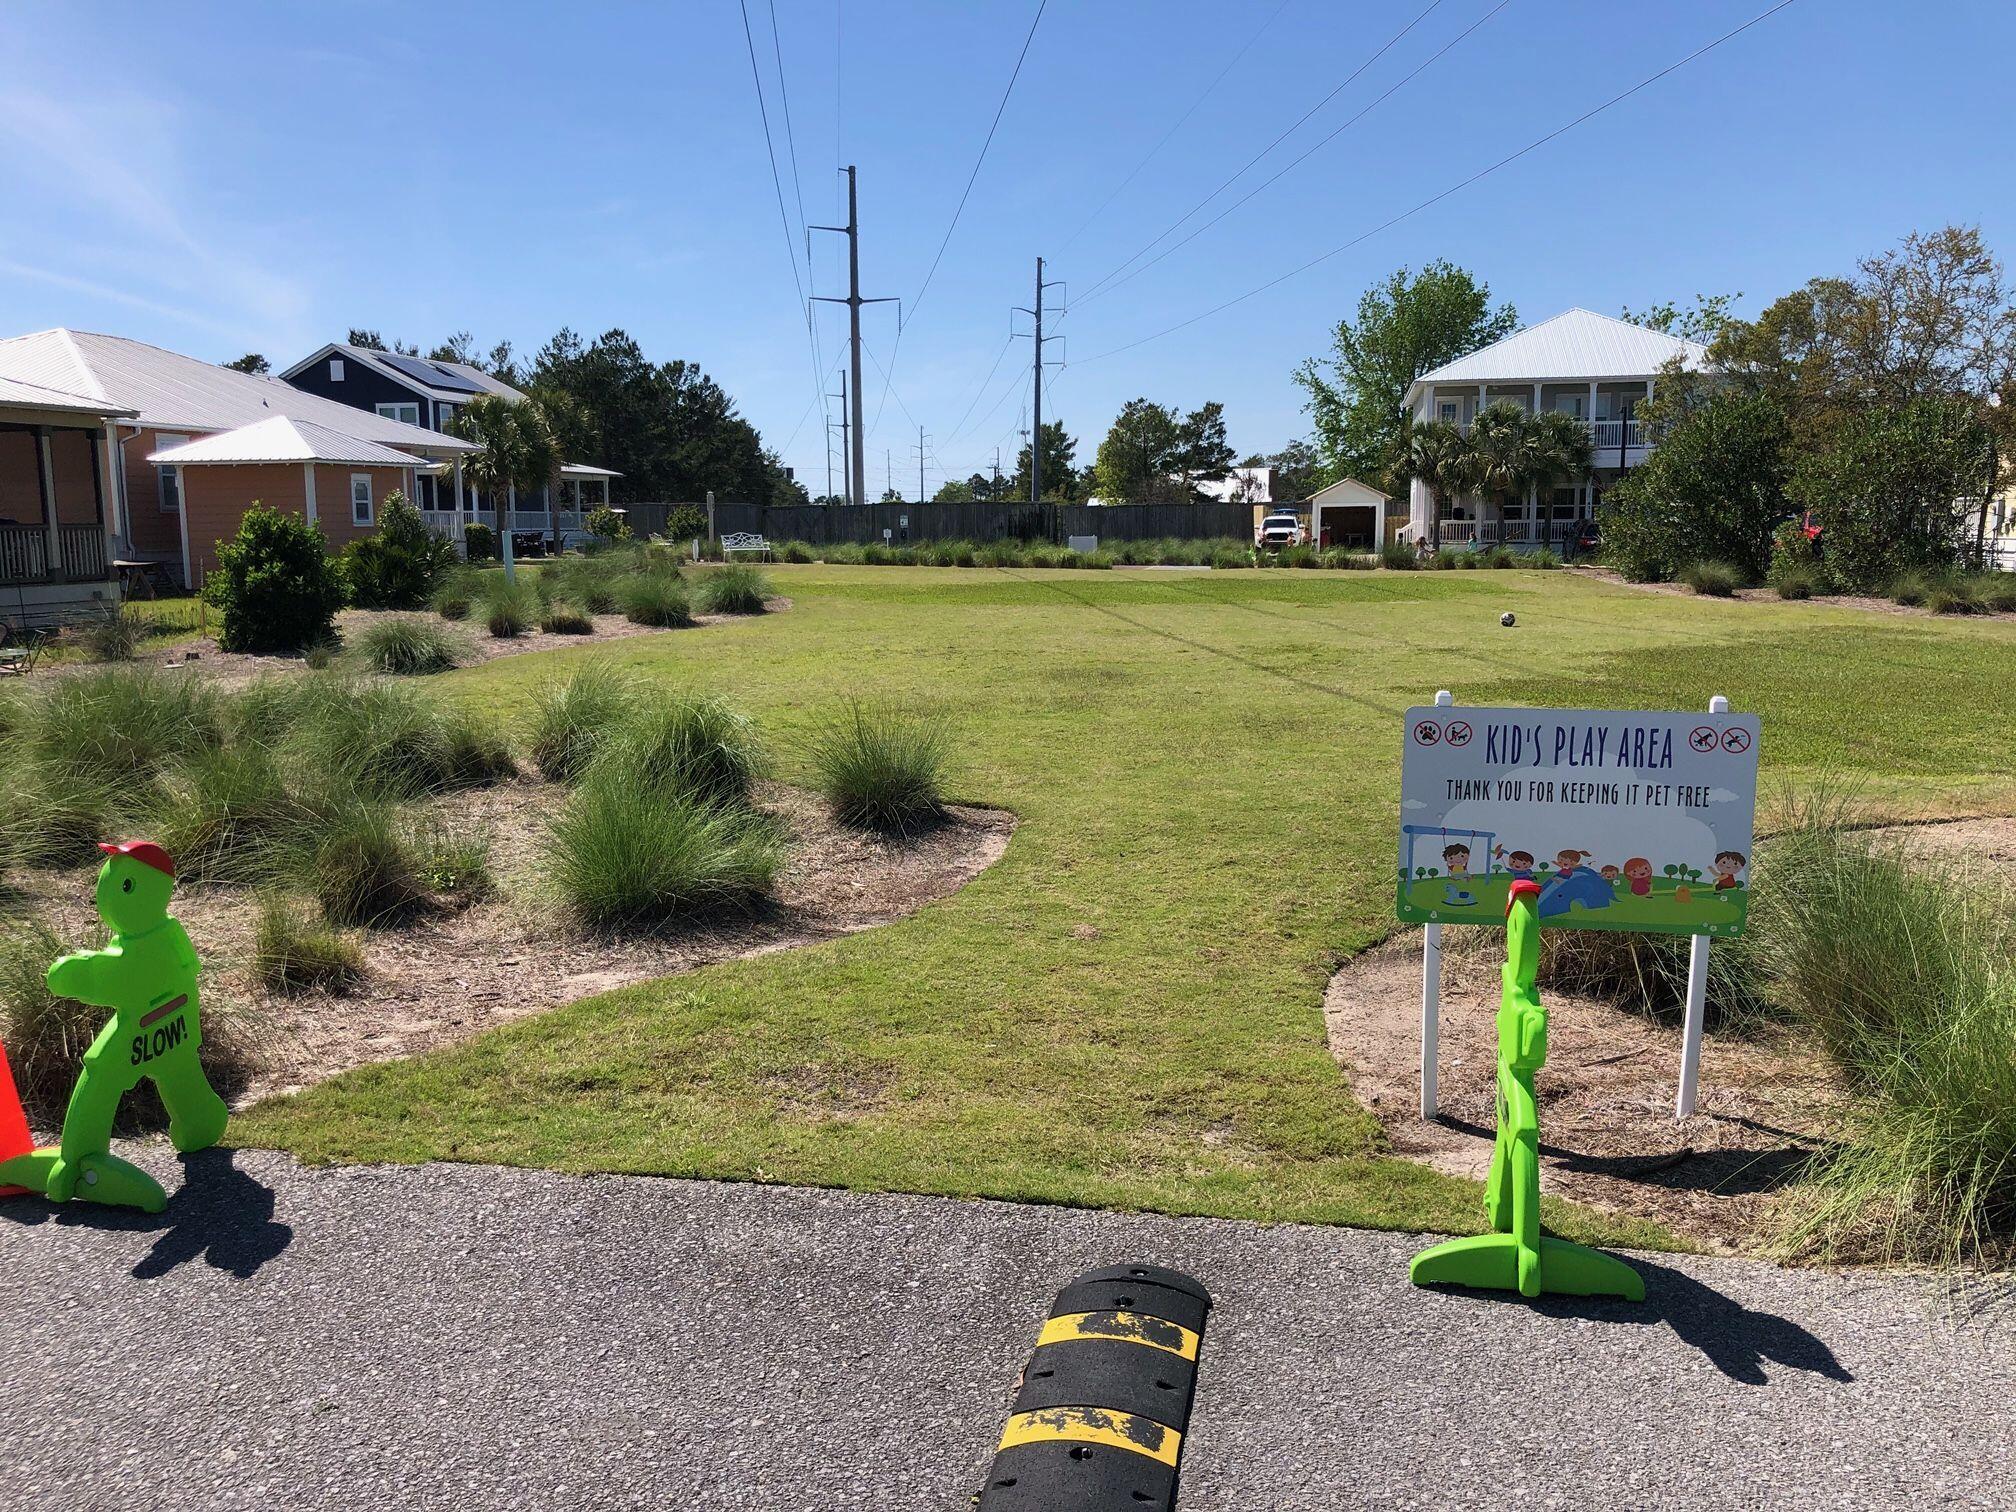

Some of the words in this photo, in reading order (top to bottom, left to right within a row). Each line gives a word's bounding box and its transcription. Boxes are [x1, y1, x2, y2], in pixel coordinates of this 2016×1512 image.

[1485, 724, 1542, 767] KID'S
[1554, 725, 1609, 768] PLAY
[1616, 727, 1673, 769] AREA
[1446, 779, 1491, 801] THANK
[1496, 780, 1522, 802] YOU
[1529, 781, 1554, 803] FOR
[1561, 782, 1619, 805] KEEPING
[1626, 784, 1640, 806] IT
[1645, 785, 1671, 807] PET
[1677, 786, 1711, 808] FREE
[131, 1014, 188, 1066] SLOW!
